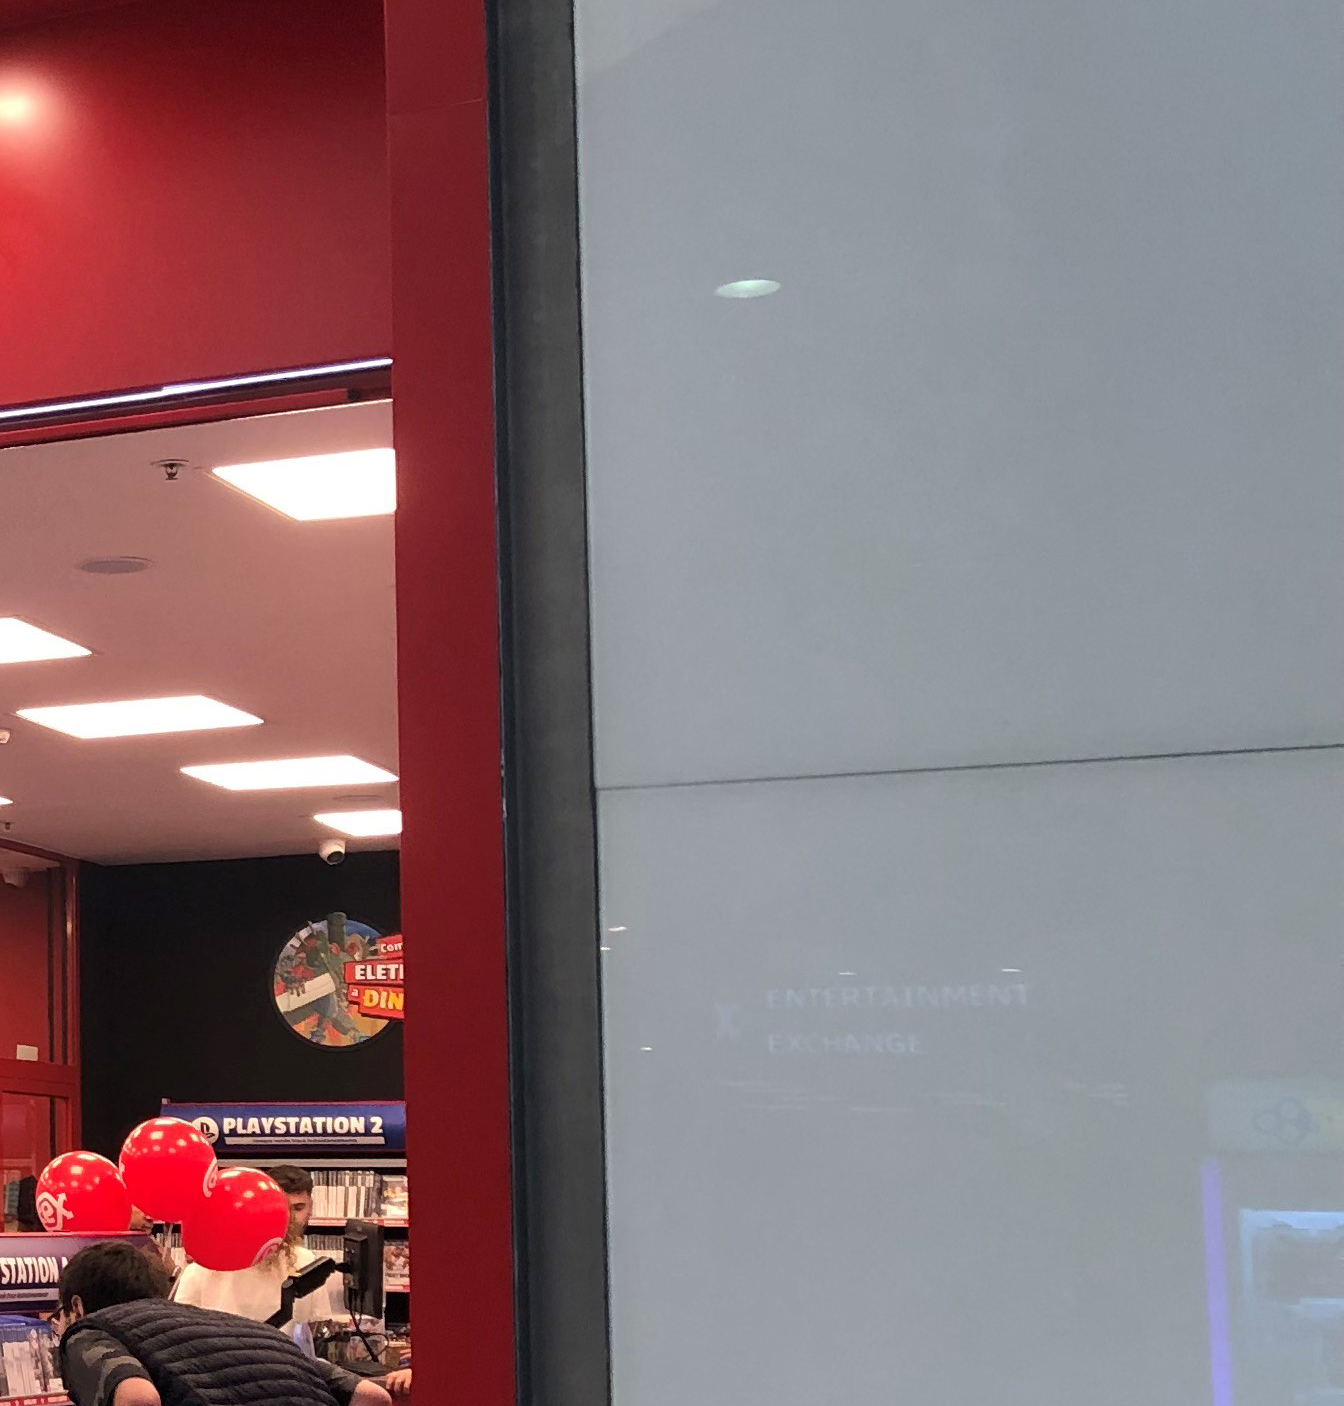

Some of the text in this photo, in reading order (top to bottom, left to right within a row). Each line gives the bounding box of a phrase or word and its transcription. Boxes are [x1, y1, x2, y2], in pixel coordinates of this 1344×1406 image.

[355, 964, 404, 980] ELET
[223, 1116, 384, 1135] PLAYSTATION 2
